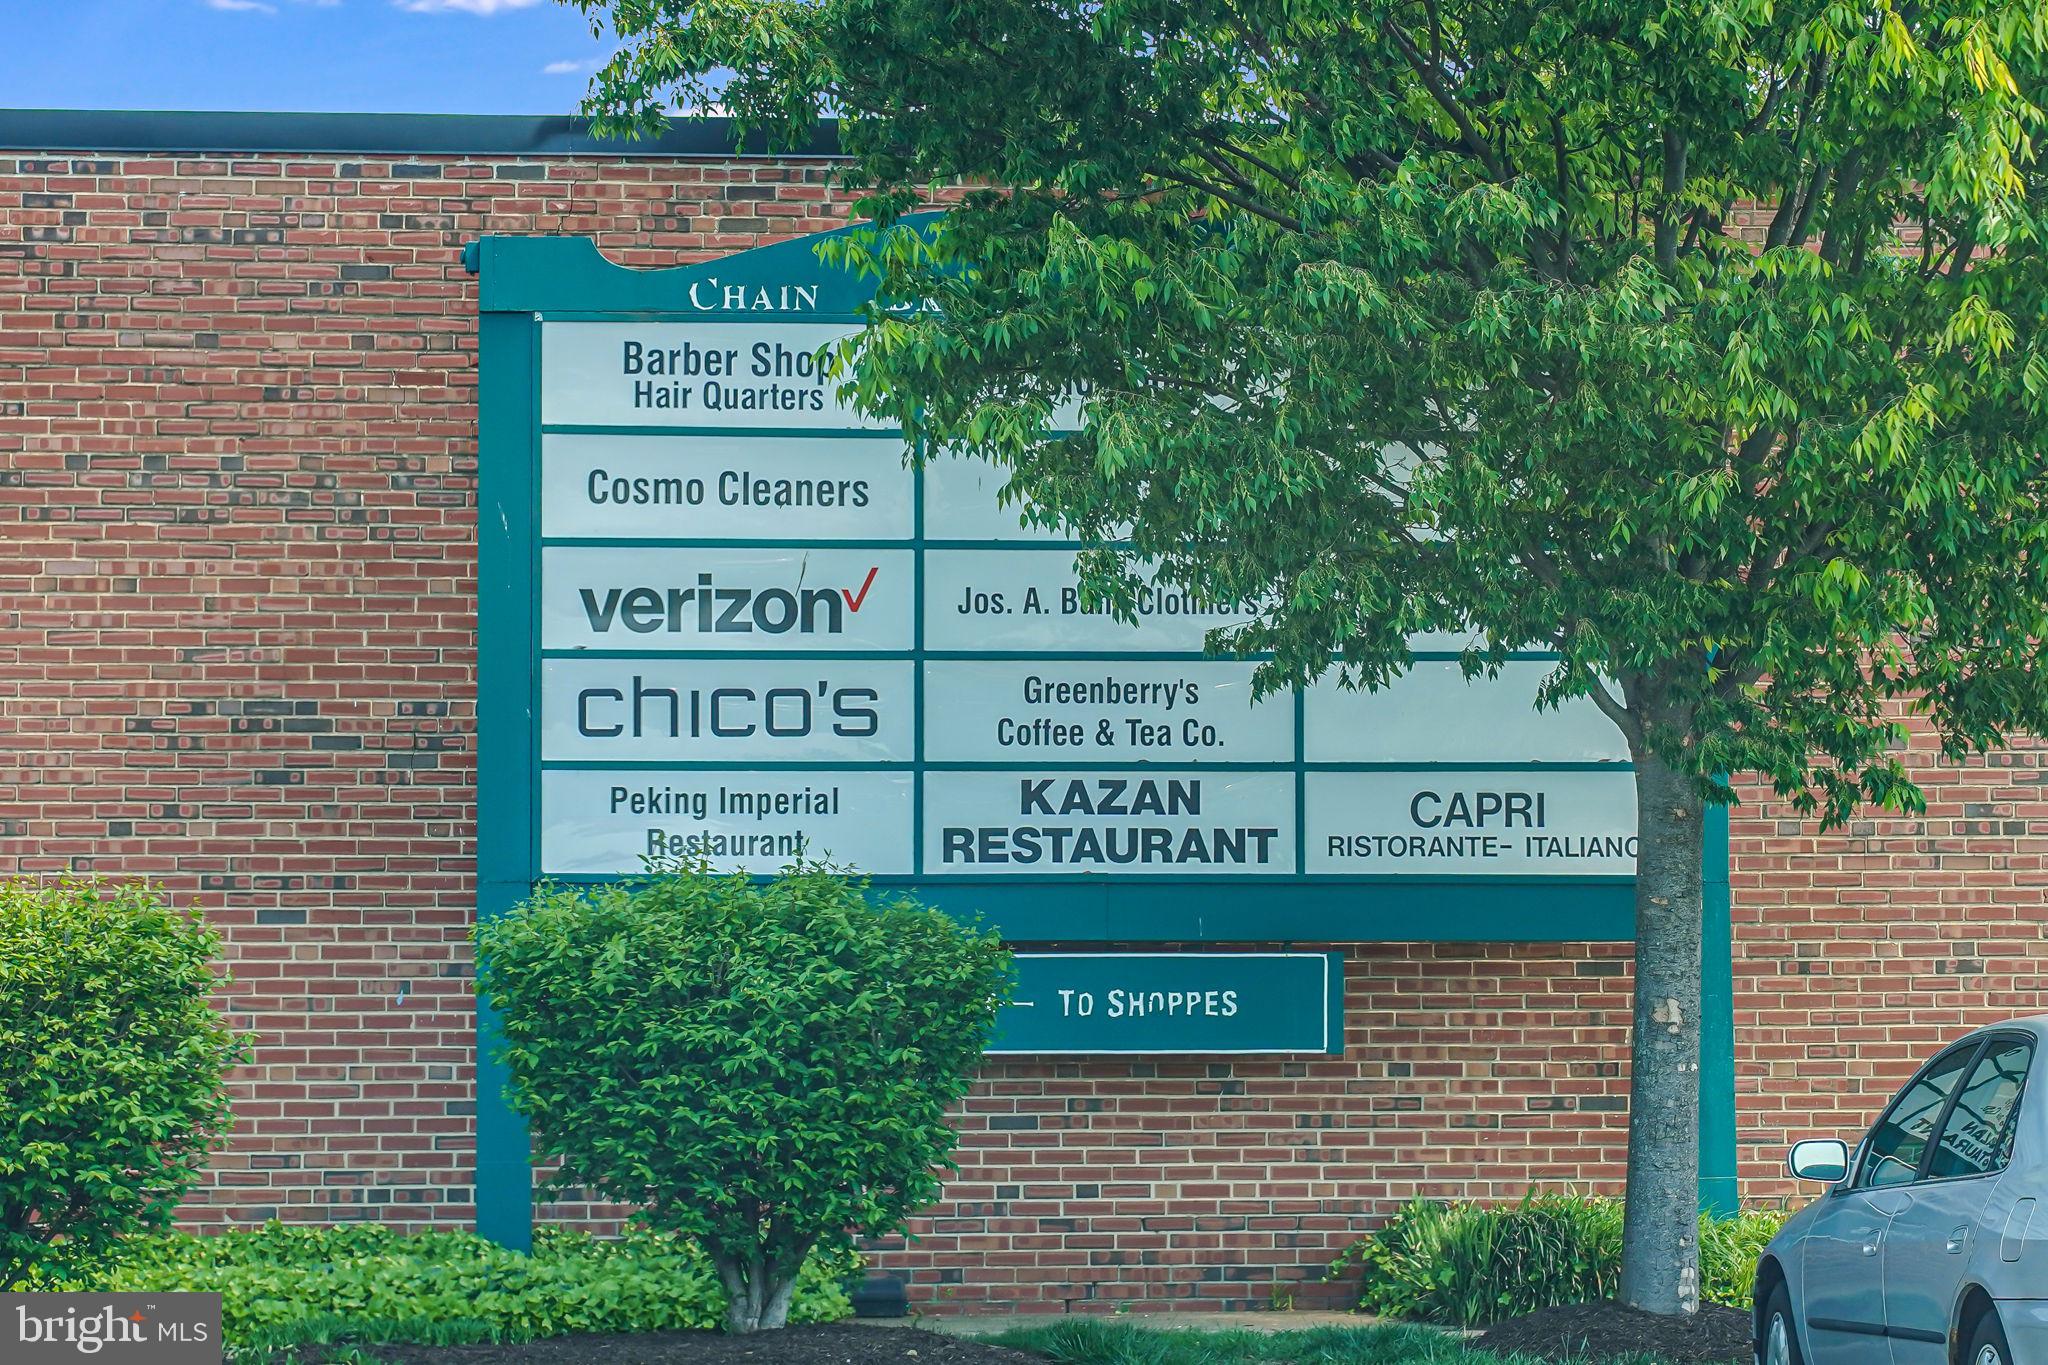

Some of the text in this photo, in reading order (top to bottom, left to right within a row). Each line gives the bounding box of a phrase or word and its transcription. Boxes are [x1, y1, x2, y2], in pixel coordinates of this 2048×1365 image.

[624, 341, 834, 386] Barber Shop
[634, 381, 824, 412] Hair Quarters
[588, 469, 869, 507] Cosmo Cleaners
[579, 573, 843, 633] verizon
[957, 587, 1012, 615] Jos.
[1023, 587, 1049, 615] A.
[578, 676, 878, 737] chico's
[1024, 676, 1199, 710] Greenberry's
[998, 718, 1224, 747] Coffee & Tea Co.
[610, 786, 839, 820] Peking Imperial
[1020, 779, 1201, 815] KAZAN
[1410, 791, 1545, 828] CAPRI
[647, 828, 804, 856] Restaurant
[943, 827, 1278, 863] RESTAURANT
[1526, 836, 1638, 857] ITALIANO
